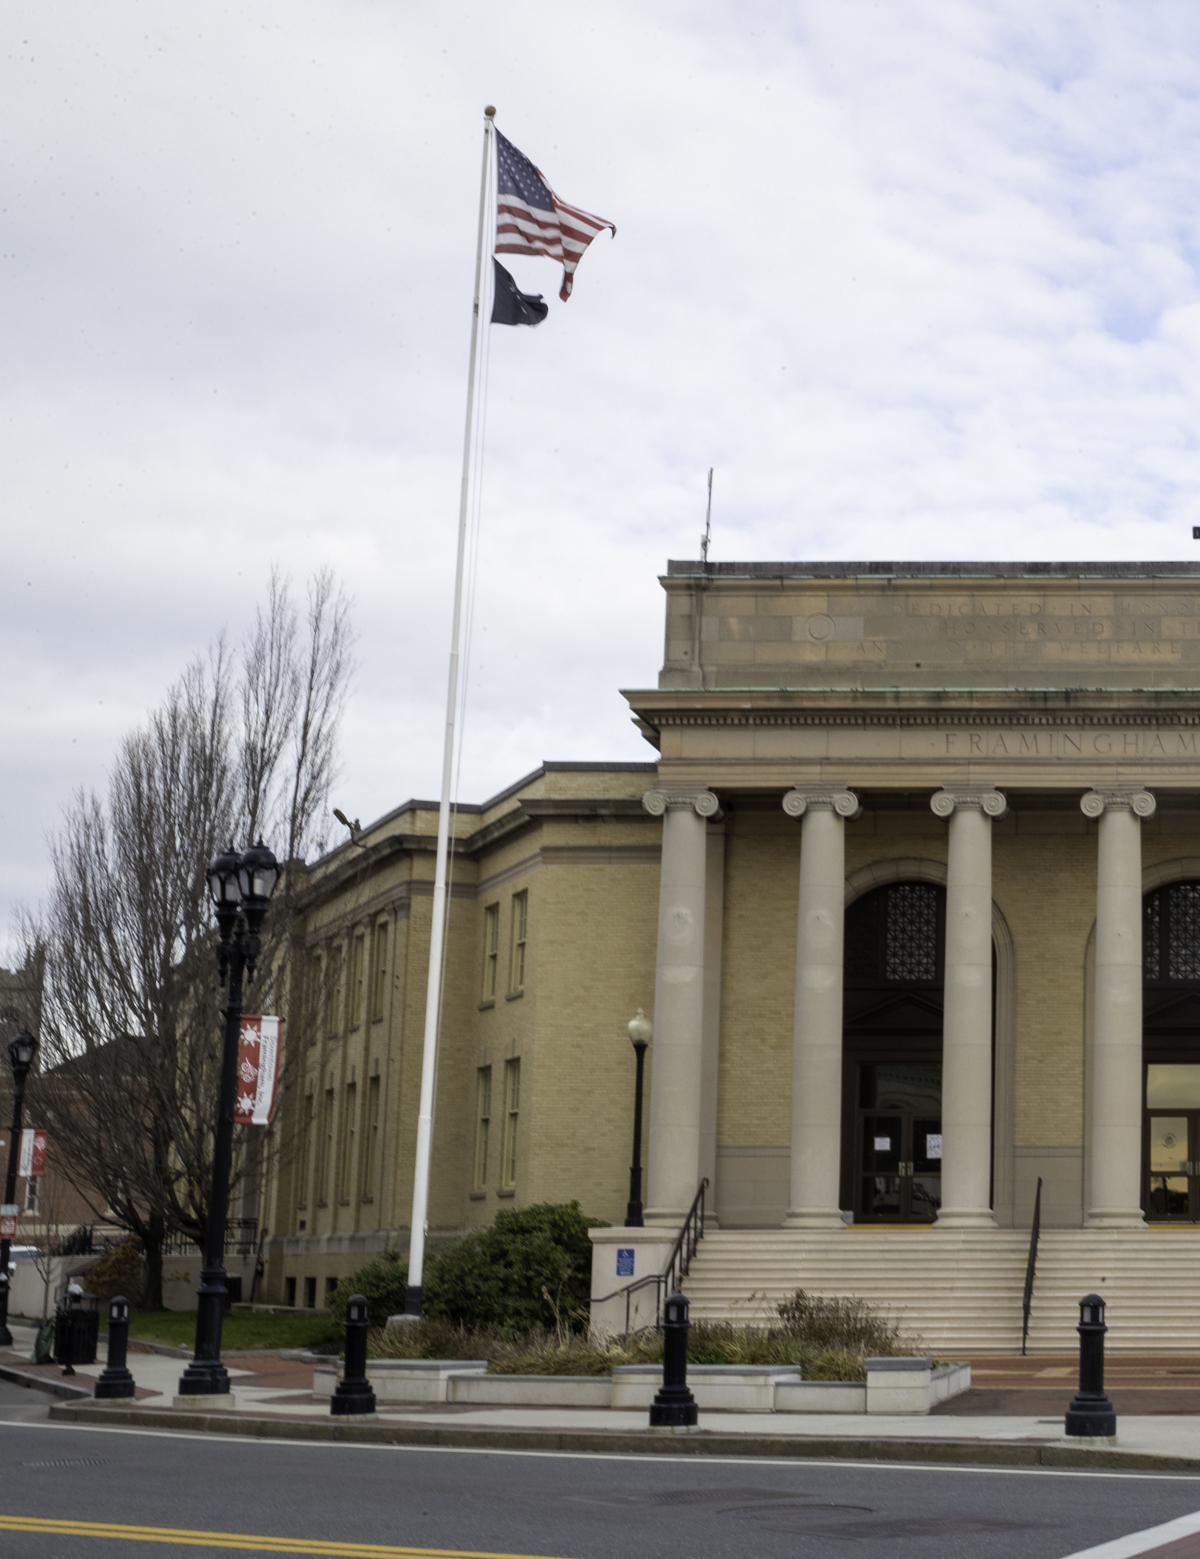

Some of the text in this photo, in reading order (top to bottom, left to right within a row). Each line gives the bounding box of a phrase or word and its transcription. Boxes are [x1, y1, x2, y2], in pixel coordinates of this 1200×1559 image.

[890, 602, 1043, 617] DEDICATED
[1069, 602, 1093, 616] IN
[922, 621, 977, 635] WHO
[1001, 621, 1105, 635] SERVED
[1131, 621, 1156, 635] IN
[987, 640, 1040, 654] THE
[1058, 640, 1183, 654] WELFARE
[944, 732, 1199, 754] FRAMINGHAM
